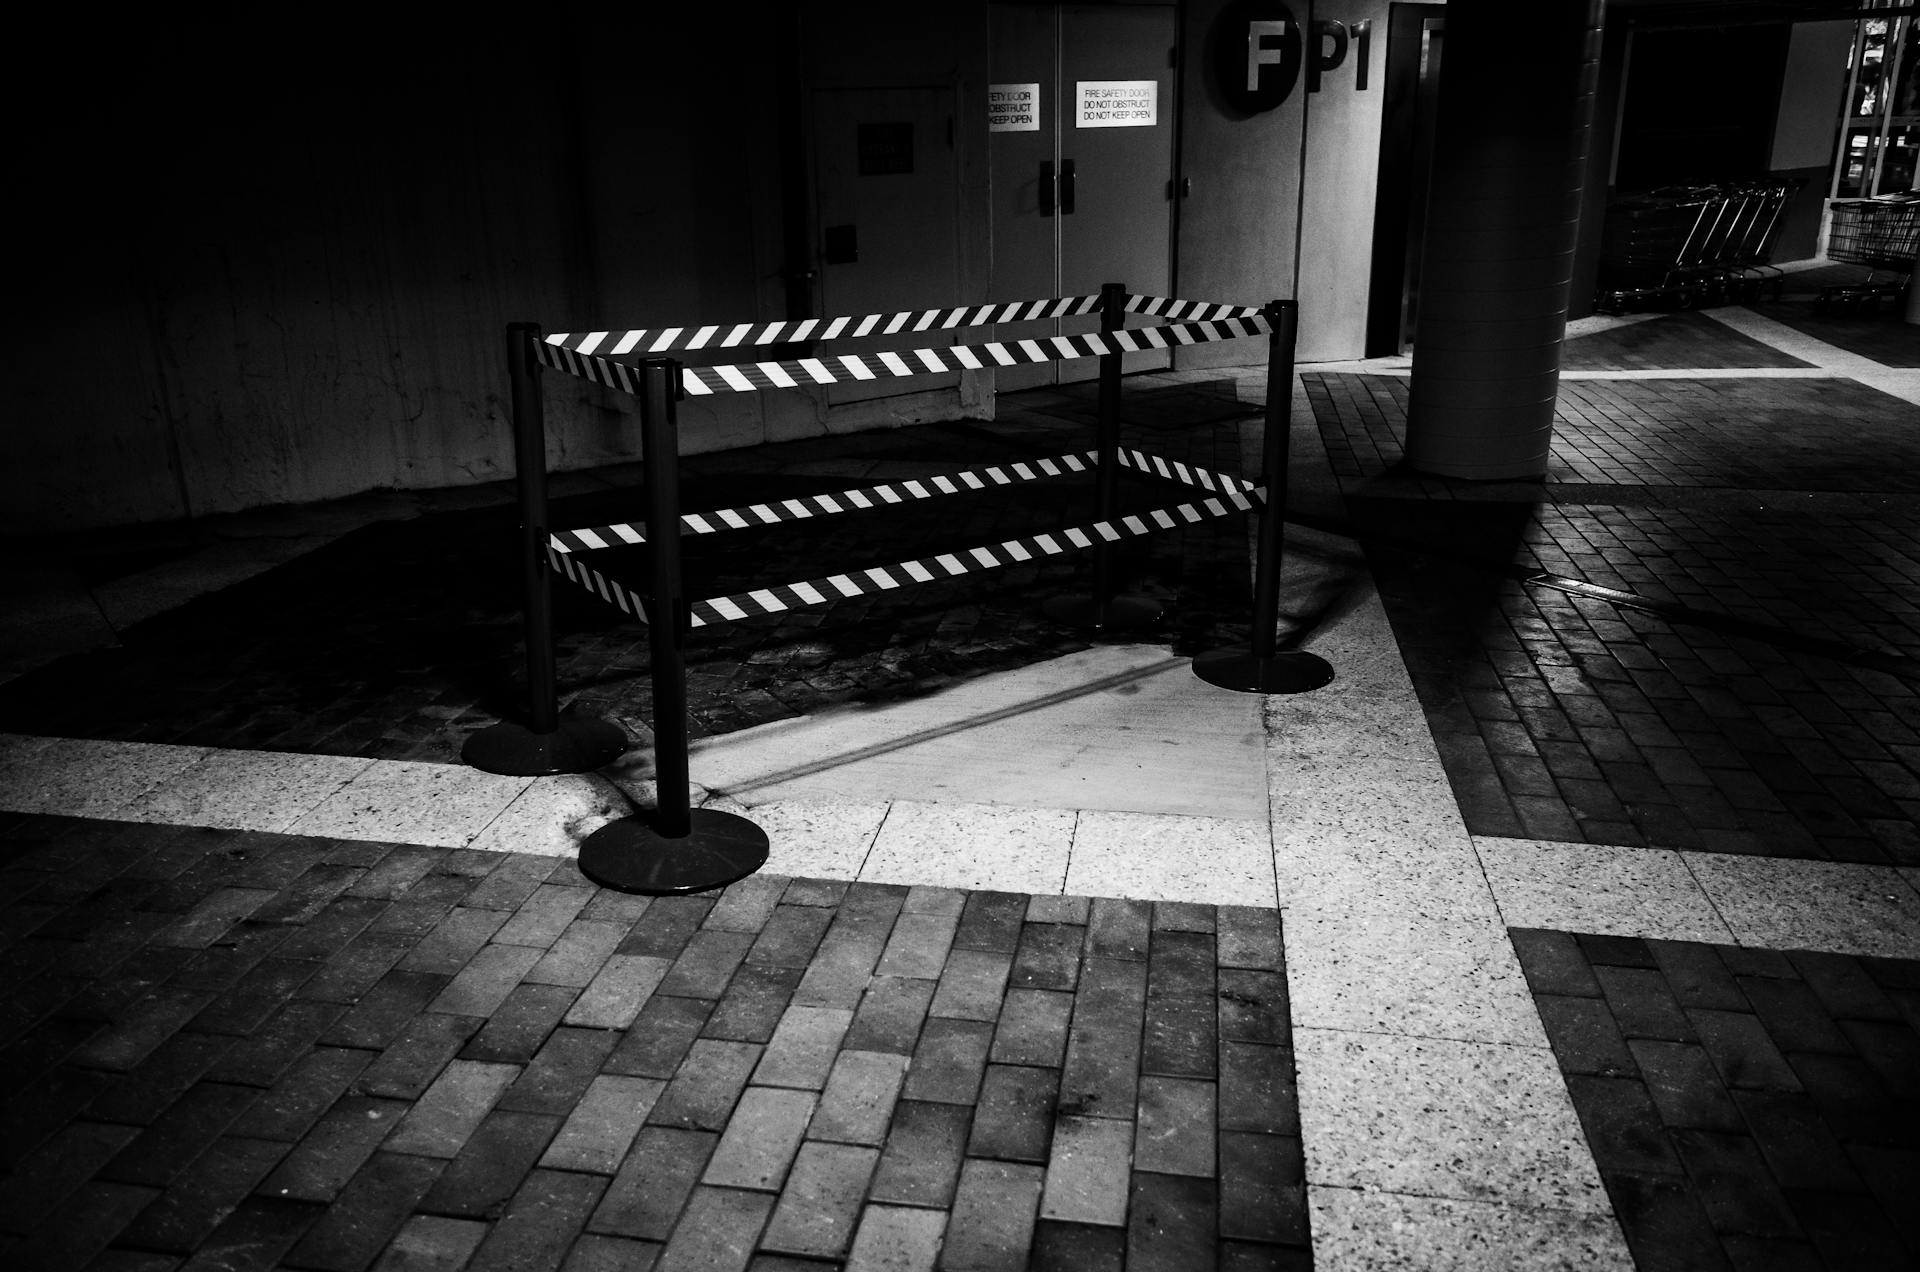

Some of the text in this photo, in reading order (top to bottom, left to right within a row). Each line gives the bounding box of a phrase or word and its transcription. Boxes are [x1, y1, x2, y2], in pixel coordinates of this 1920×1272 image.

[1247, 20, 1285, 91] F
[1307, 18, 1371, 92] P1
[1085, 88, 1149, 97] FIRE SAFETY DOOR
[1084, 99, 1150, 109] DO NOT OBSTRUCT
[1011, 114, 1032, 123] OPEN
[1084, 110, 1150, 120] DO NOT KEEP OPEN
